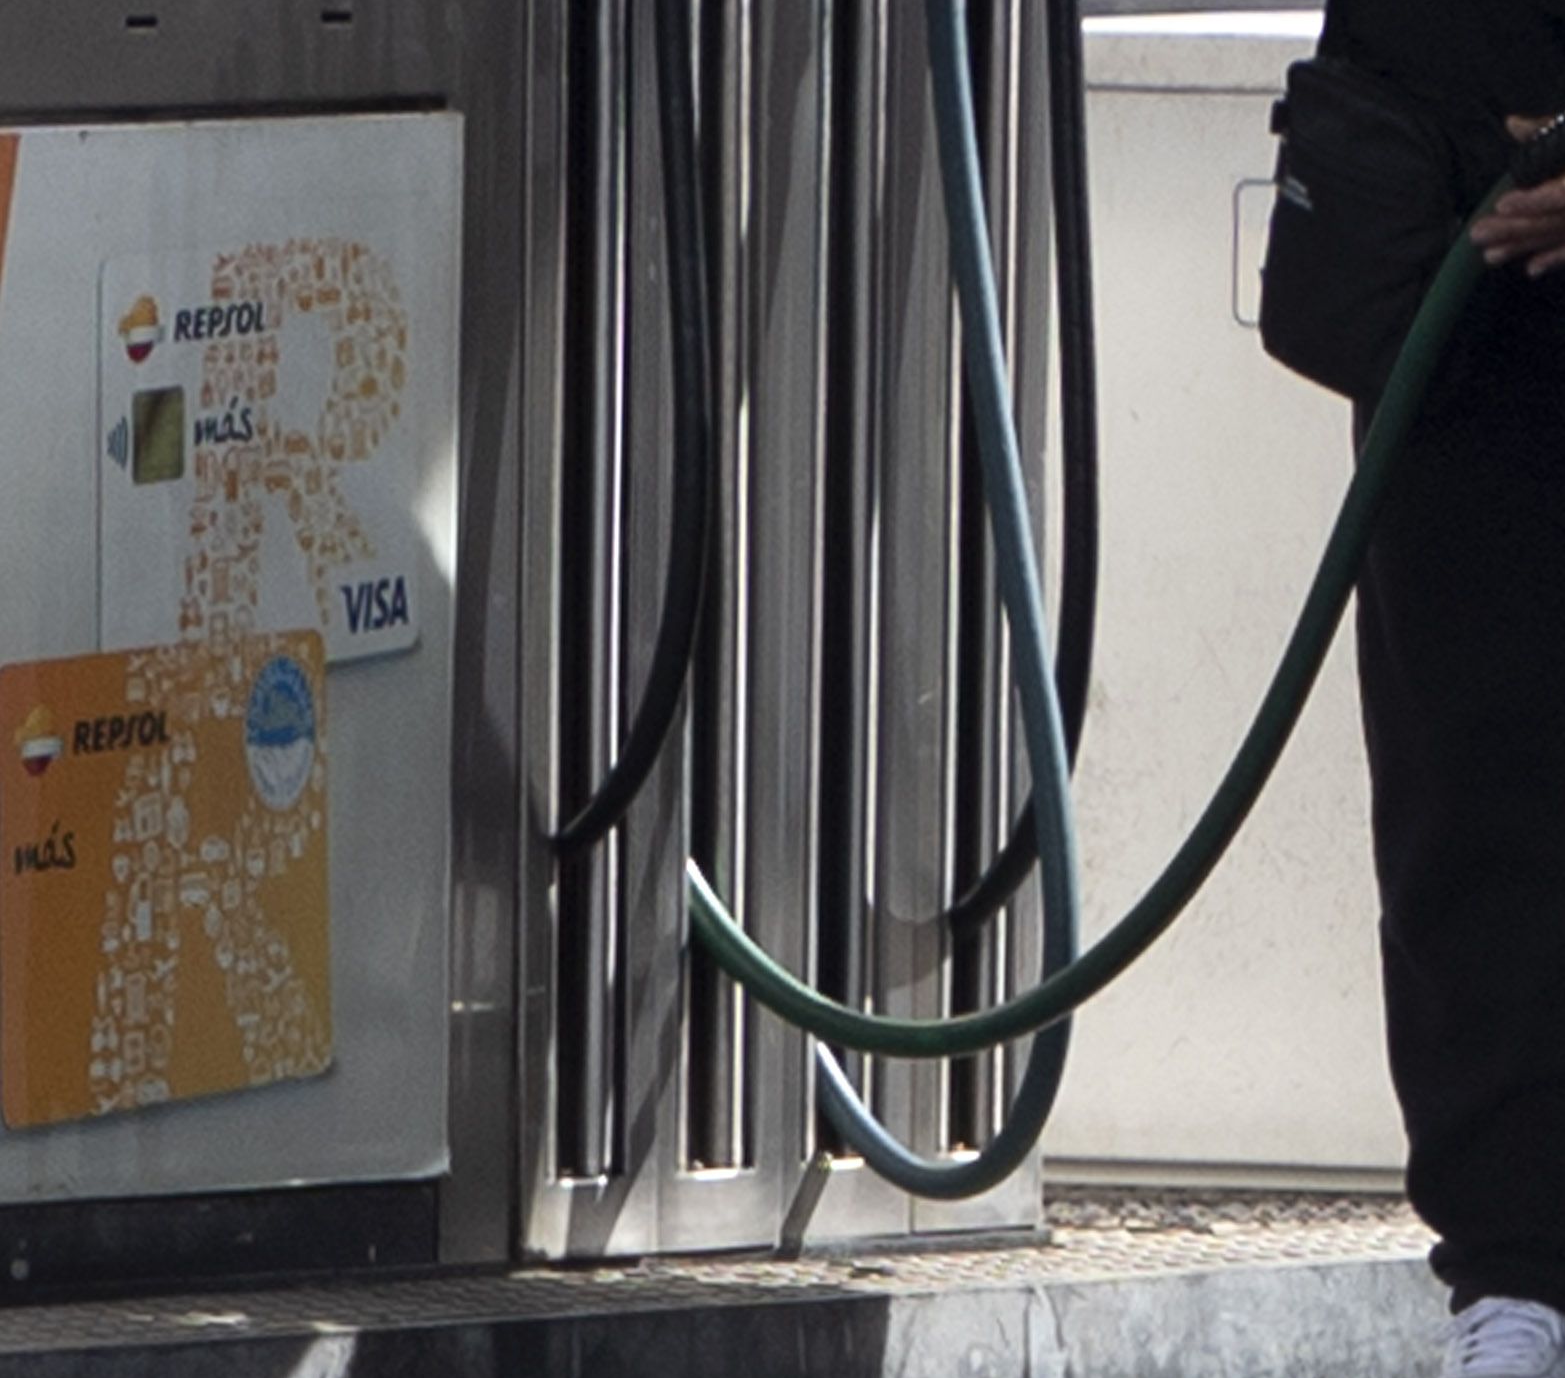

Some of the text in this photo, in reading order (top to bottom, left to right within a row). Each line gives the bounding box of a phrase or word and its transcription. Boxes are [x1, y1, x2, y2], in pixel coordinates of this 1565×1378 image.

[174, 302, 265, 342] REPSOL
[194, 395, 253, 446] más
[340, 575, 410, 634] VISA
[73, 711, 170, 755] REPSOL
[14, 822, 76, 874] más
